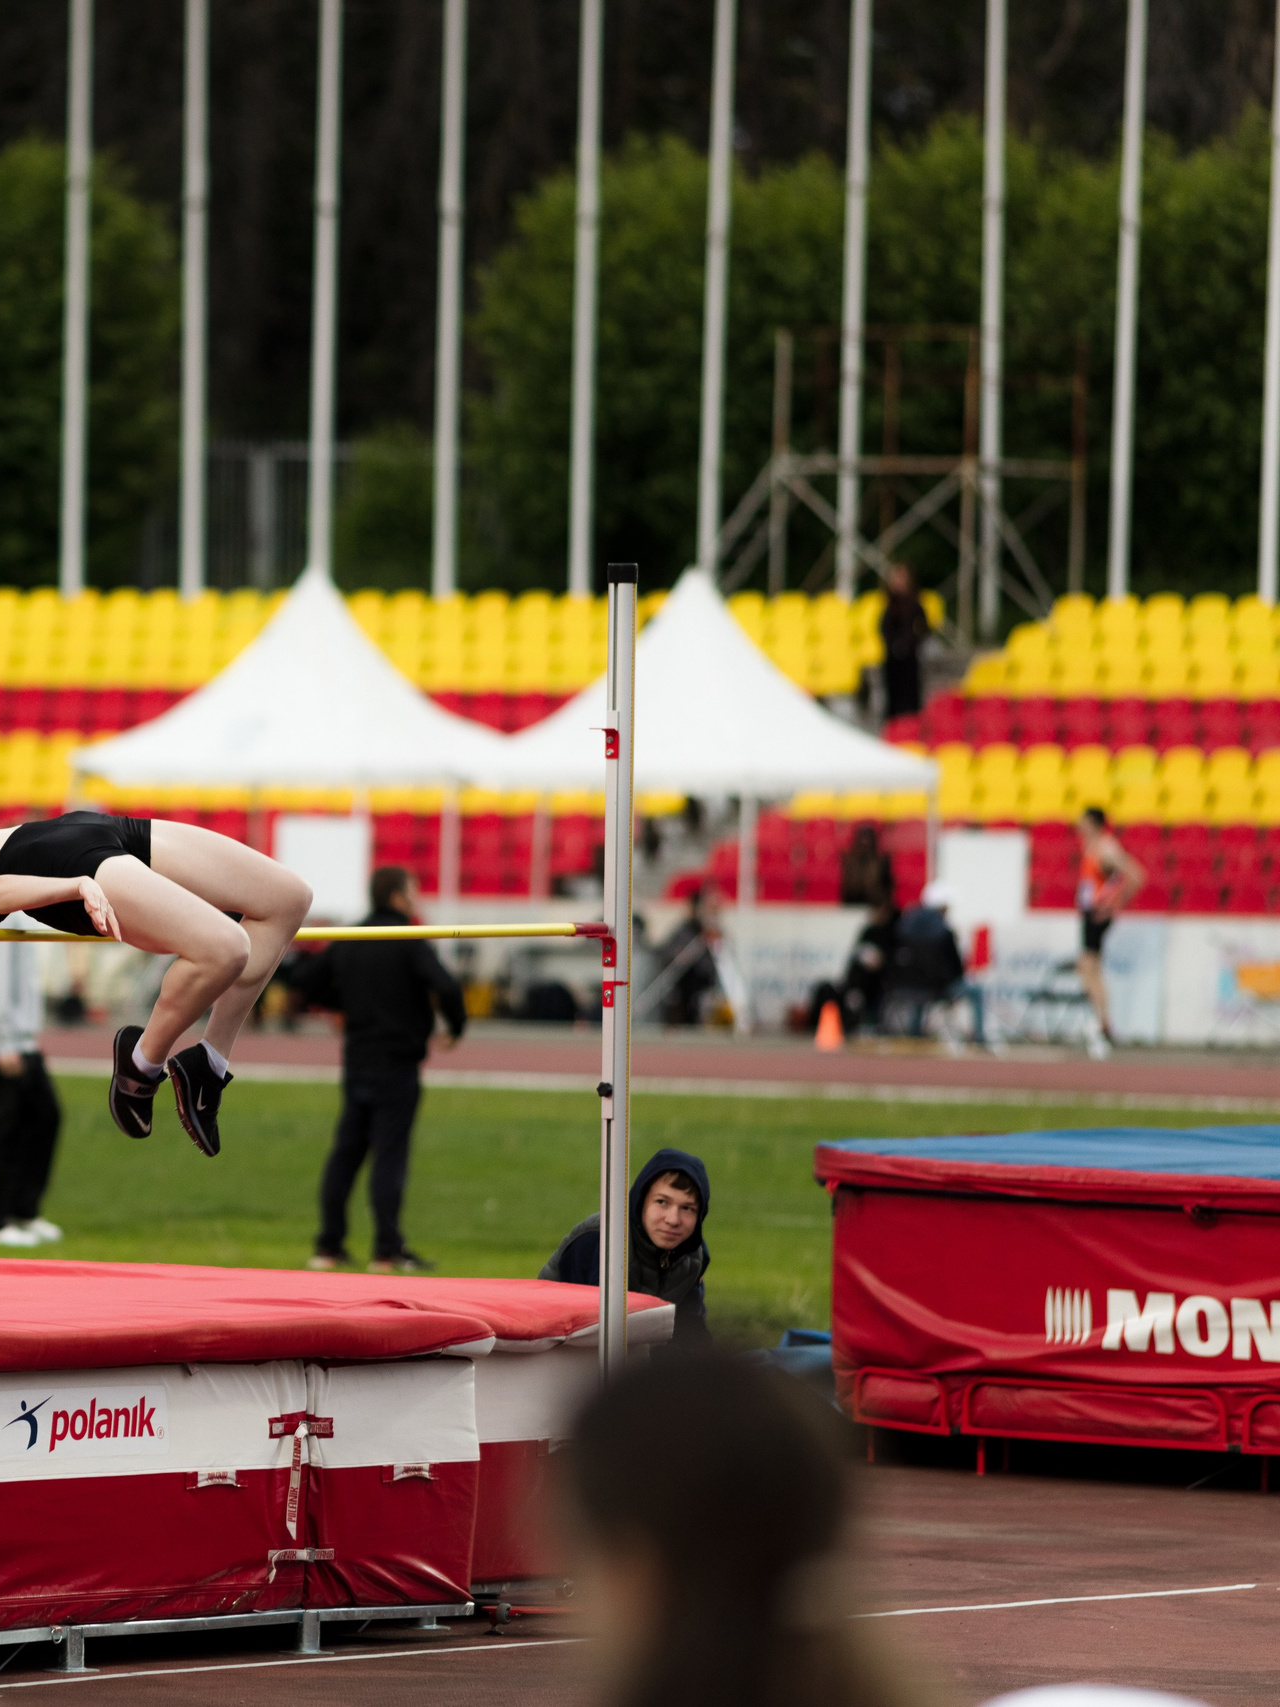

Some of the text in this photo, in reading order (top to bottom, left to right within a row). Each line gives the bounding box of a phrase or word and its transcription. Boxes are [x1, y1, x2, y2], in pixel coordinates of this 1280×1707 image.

[1101, 1288, 1280, 1363] MON
[49, 1395, 156, 1453] polanik
[288, 1487, 298, 1522] POLANIK
